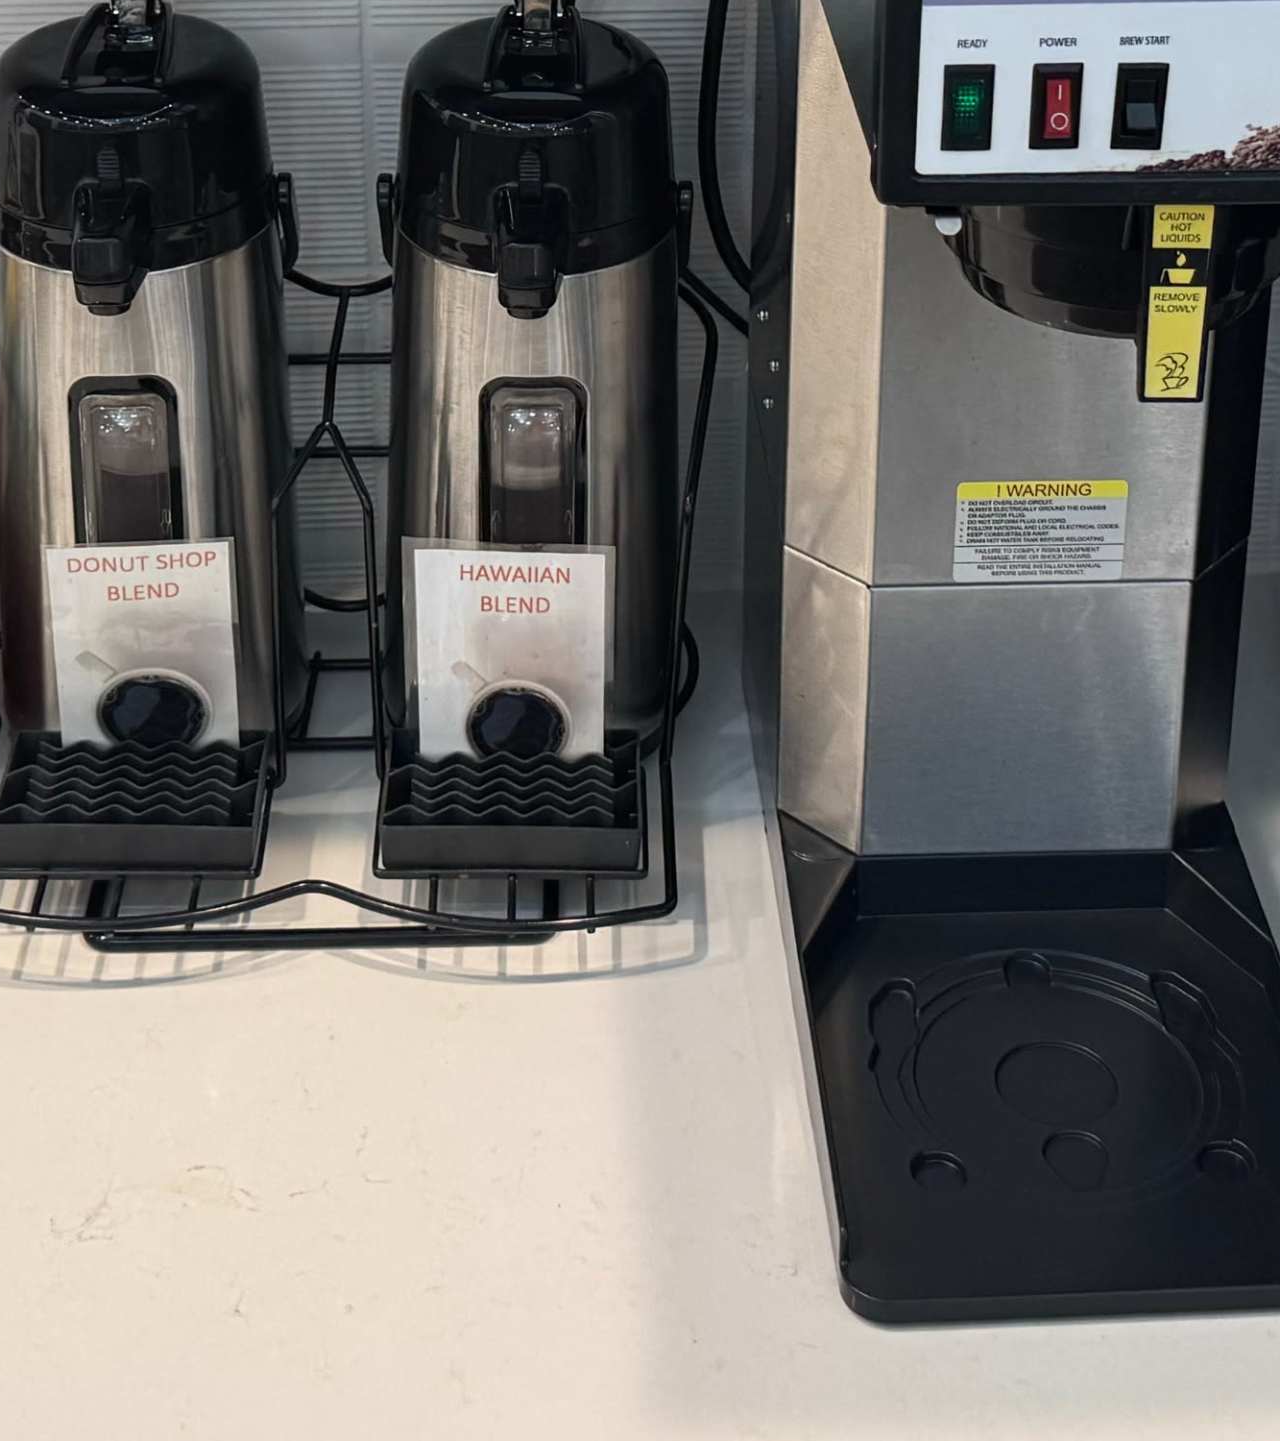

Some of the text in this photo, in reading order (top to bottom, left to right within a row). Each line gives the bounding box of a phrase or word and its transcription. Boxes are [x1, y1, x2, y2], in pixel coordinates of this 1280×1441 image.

[957, 39, 988, 48] READY
[1039, 37, 1077, 47] POWER
[1120, 35, 1171, 46] BREW START
[1159, 212, 1205, 221] CAUTION
[1170, 223, 1192, 232] HOT
[1161, 234, 1201, 243] LIQUIDS
[1154, 293, 1200, 302] REMOVE
[1154, 305, 1198, 313] SLOWLY
[1007, 483, 1092, 497] WARNING
[67, 550, 218, 574] DONUT SHOP
[460, 565, 571, 585] HAWAIIAN
[107, 582, 180, 602] BLEND
[480, 594, 551, 615] BLEND
